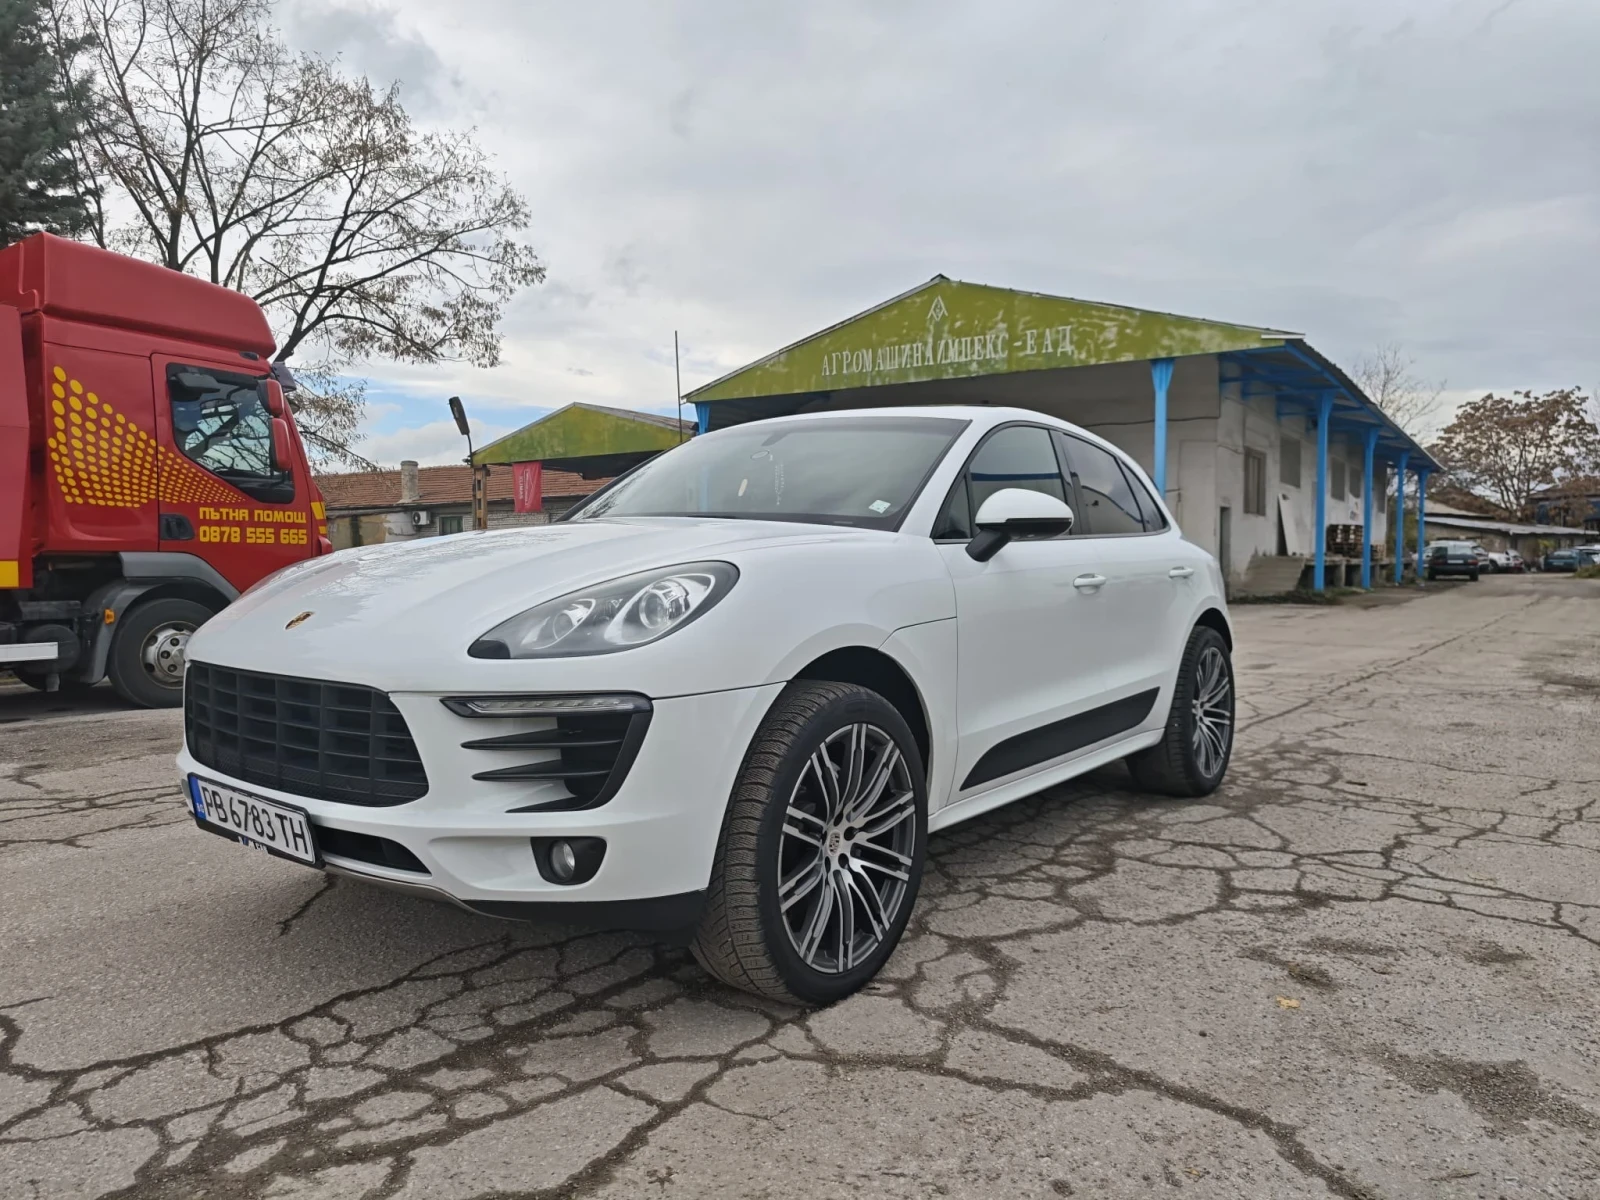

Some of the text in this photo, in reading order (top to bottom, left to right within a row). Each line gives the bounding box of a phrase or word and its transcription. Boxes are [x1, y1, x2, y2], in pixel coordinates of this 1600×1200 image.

[254, 509, 307, 523] ПОМОЩ
[199, 526, 308, 545] 0878 555 665
